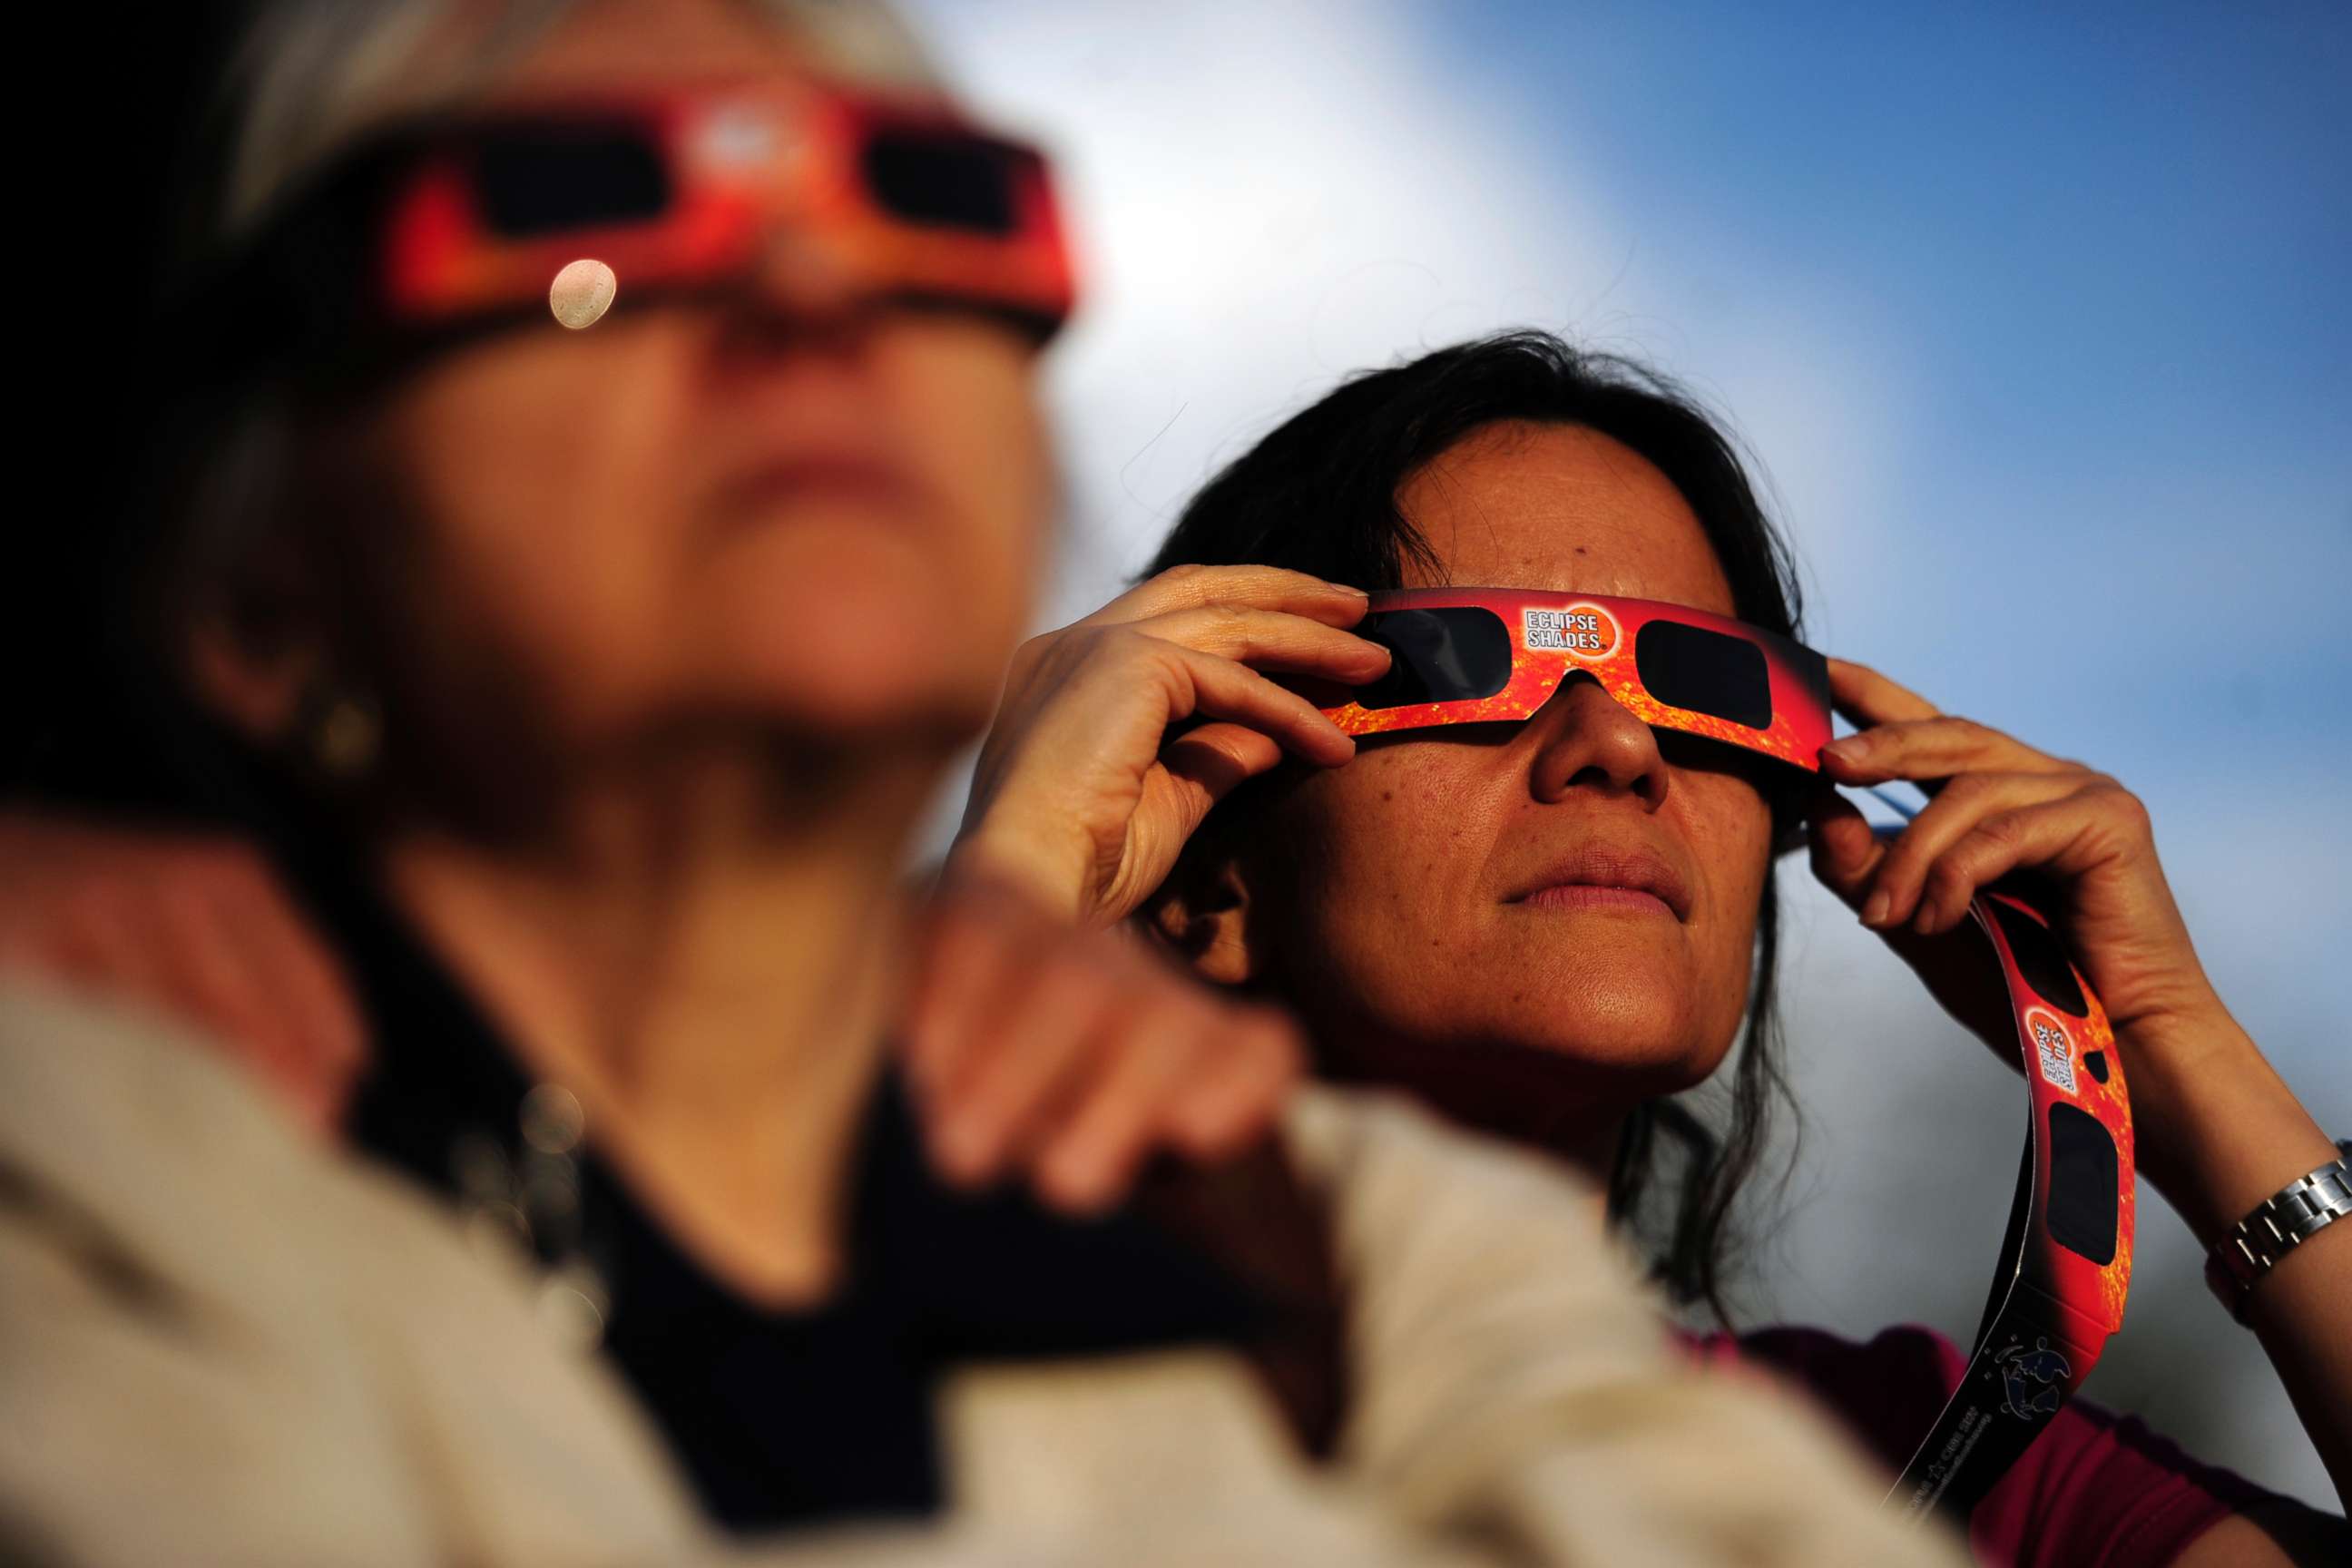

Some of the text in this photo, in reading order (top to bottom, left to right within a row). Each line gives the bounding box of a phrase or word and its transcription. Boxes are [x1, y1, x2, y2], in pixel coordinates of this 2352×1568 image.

[1526, 611, 1598, 631] ECLIPSE
[1528, 630, 1601, 649] SHADES
[2034, 1020, 2059, 1083] ECLIPSE
[2051, 1029, 2075, 1092] SHADES
